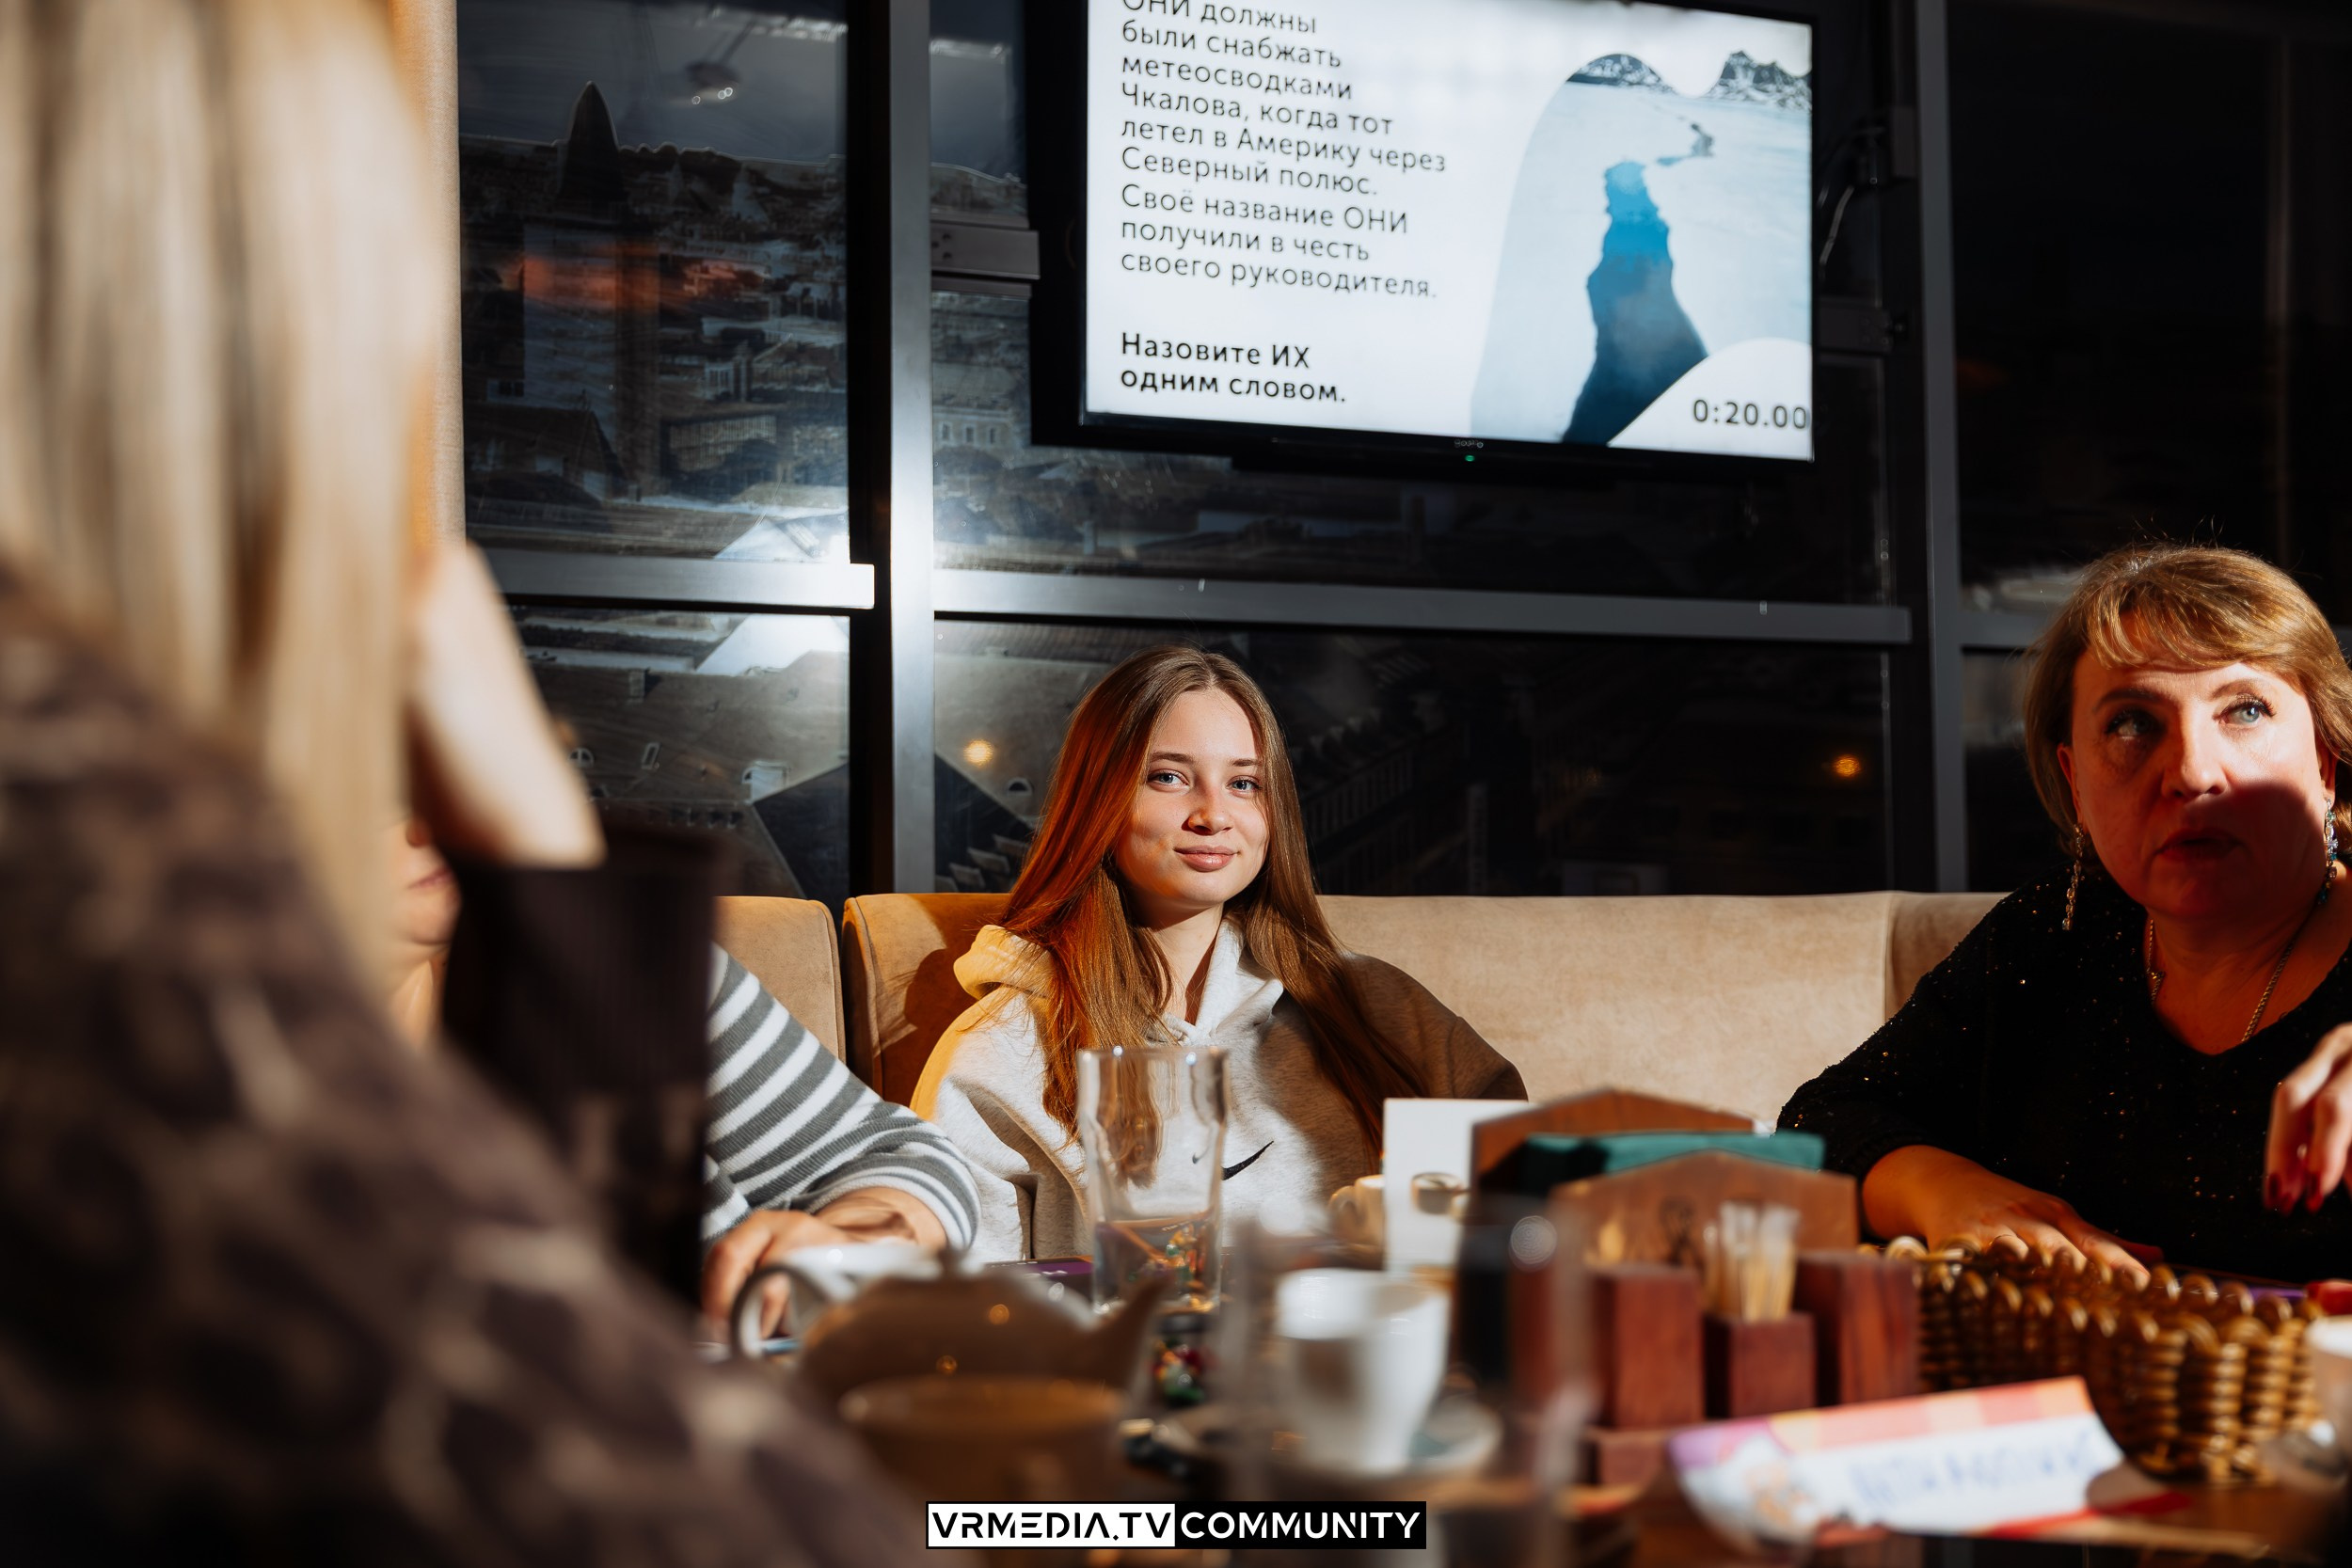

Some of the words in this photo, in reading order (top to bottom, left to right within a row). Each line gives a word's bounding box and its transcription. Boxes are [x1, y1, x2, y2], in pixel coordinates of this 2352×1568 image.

[1200, 4, 1315, 33] должны
[1122, 19, 1196, 50] были
[1206, 36, 1341, 68] снабжать
[1122, 56, 1351, 100] метеосводками
[1122, 82, 1248, 121] Чкалова,
[1261, 105, 1338, 131] когда
[1348, 115, 1392, 135] тот
[1121, 120, 1202, 145] летел
[1215, 131, 1227, 148] в
[1237, 128, 1360, 168] Америку
[1370, 149, 1445, 173] через
[1122, 146, 1268, 183] Северный
[1280, 169, 1376, 195] полюс.
[1121, 183, 1193, 213] Своё
[1205, 198, 1333, 227] название
[1343, 207, 1406, 233] ОНИ
[1122, 222, 1260, 250] получили
[1272, 236, 1283, 252] в
[1294, 239, 1369, 261] честь
[1121, 254, 1220, 278] своего
[1232, 264, 1437, 298] руководителя.
[1122, 332, 1261, 365] Назовите
[1272, 344, 1310, 369] ИХ
[1120, 370, 1218, 393] одним
[1229, 378, 1345, 403] словом.
[1692, 399, 1806, 429] 0:20.00
